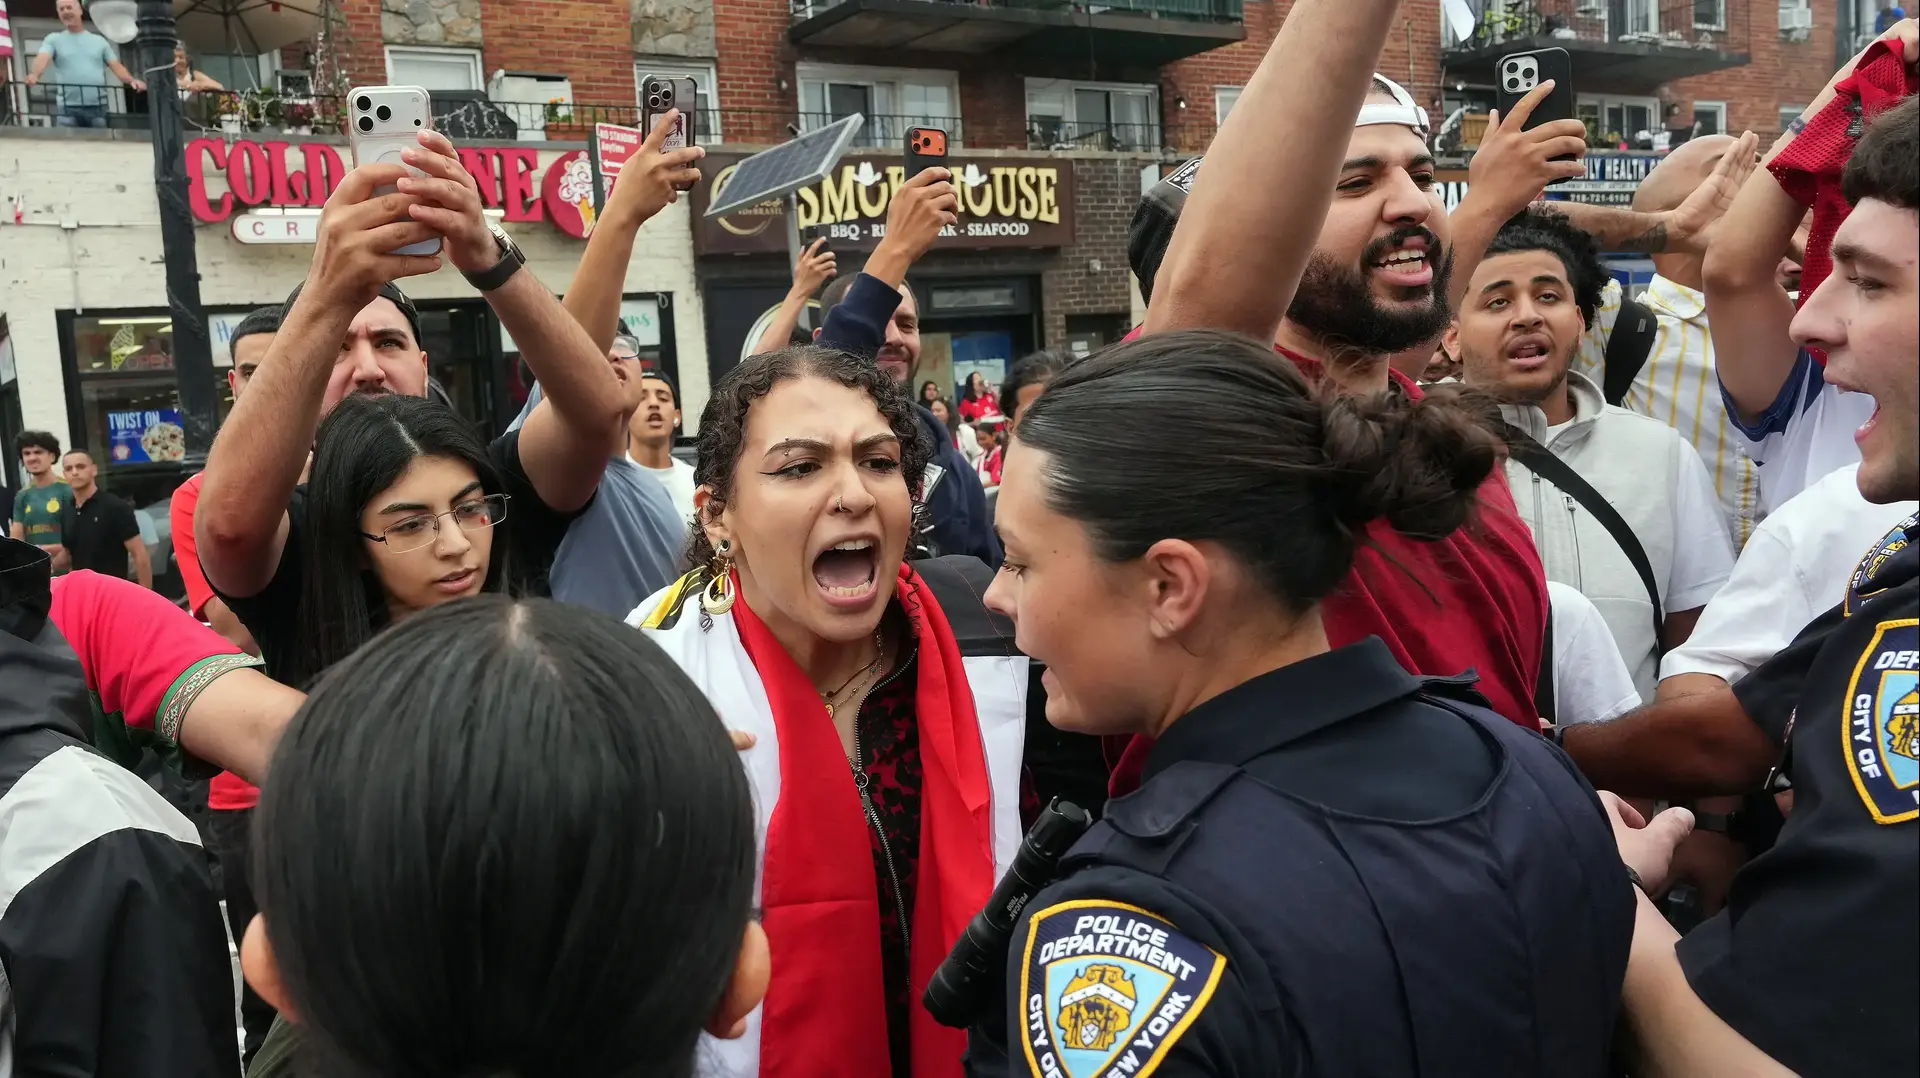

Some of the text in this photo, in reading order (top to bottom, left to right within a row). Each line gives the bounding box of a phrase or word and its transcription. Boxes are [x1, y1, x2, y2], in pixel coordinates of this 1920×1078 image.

[184, 136, 345, 222] COLD
[1605, 158, 1645, 180] HEALTH
[830, 223, 860, 241] BBQ
[967, 222, 1030, 236] SEAFOOD
[107, 410, 161, 430] TWIST ON
[1853, 693, 1882, 779] CITY OF
[1073, 914, 1169, 948] POLICE
[1038, 934, 1196, 981] DEPARTMENT
[1029, 991, 1192, 1078] CITY OF EW YORK
